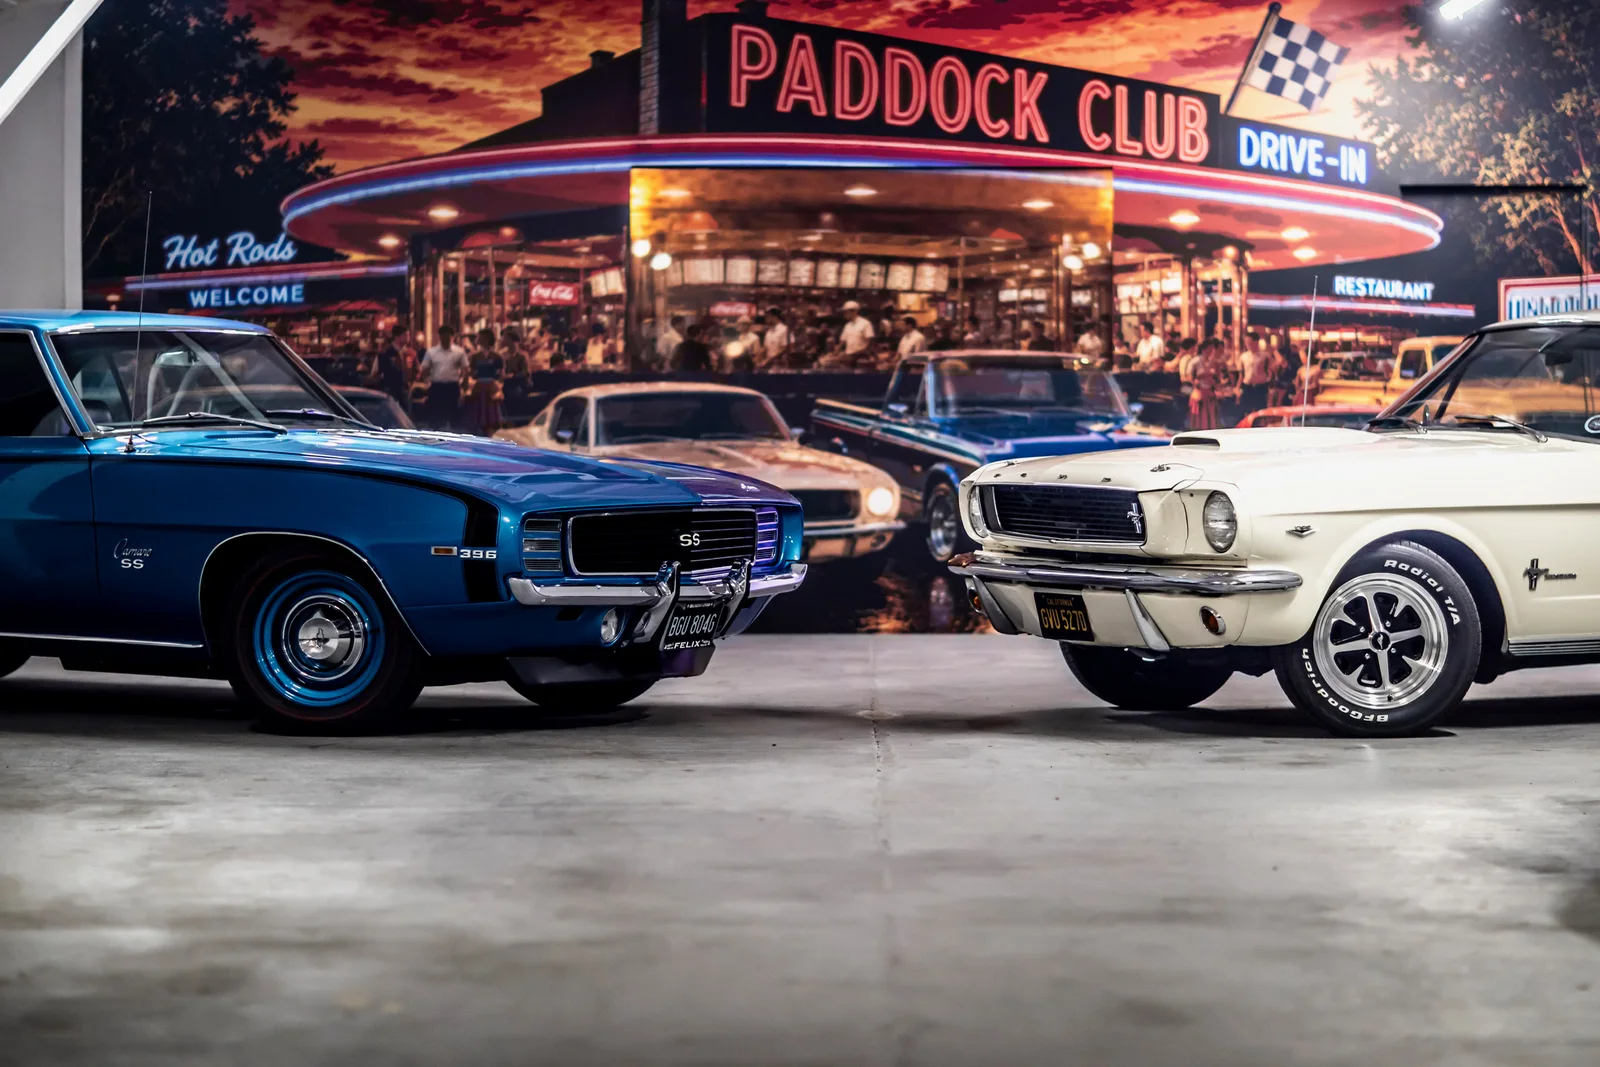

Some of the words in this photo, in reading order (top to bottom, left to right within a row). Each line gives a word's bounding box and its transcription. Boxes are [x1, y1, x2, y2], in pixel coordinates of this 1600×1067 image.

[730, 23, 1050, 144] PADDOCK
[1077, 79, 1210, 164] CLUB
[1238, 126, 1368, 185] DRIVE-IN
[163, 233, 220, 270] Hot
[226, 230, 299, 267] Rods
[189, 283, 306, 309] WELCOME
[1333, 274, 1436, 301] RESTAURANT
[113, 538, 153, 559] Camaro
[679, 532, 701, 547] SS
[120, 558, 145, 570] SS
[459, 548, 497, 559] 396
[1383, 559, 1445, 593] Radial
[1443, 595, 1461, 626] T/A
[668, 615, 691, 636] BGU
[689, 613, 718, 635] 804G
[1040, 608, 1061, 629] GVU
[673, 640, 701, 650] FELIX
[1301, 647, 1389, 723] BFGoodrich
